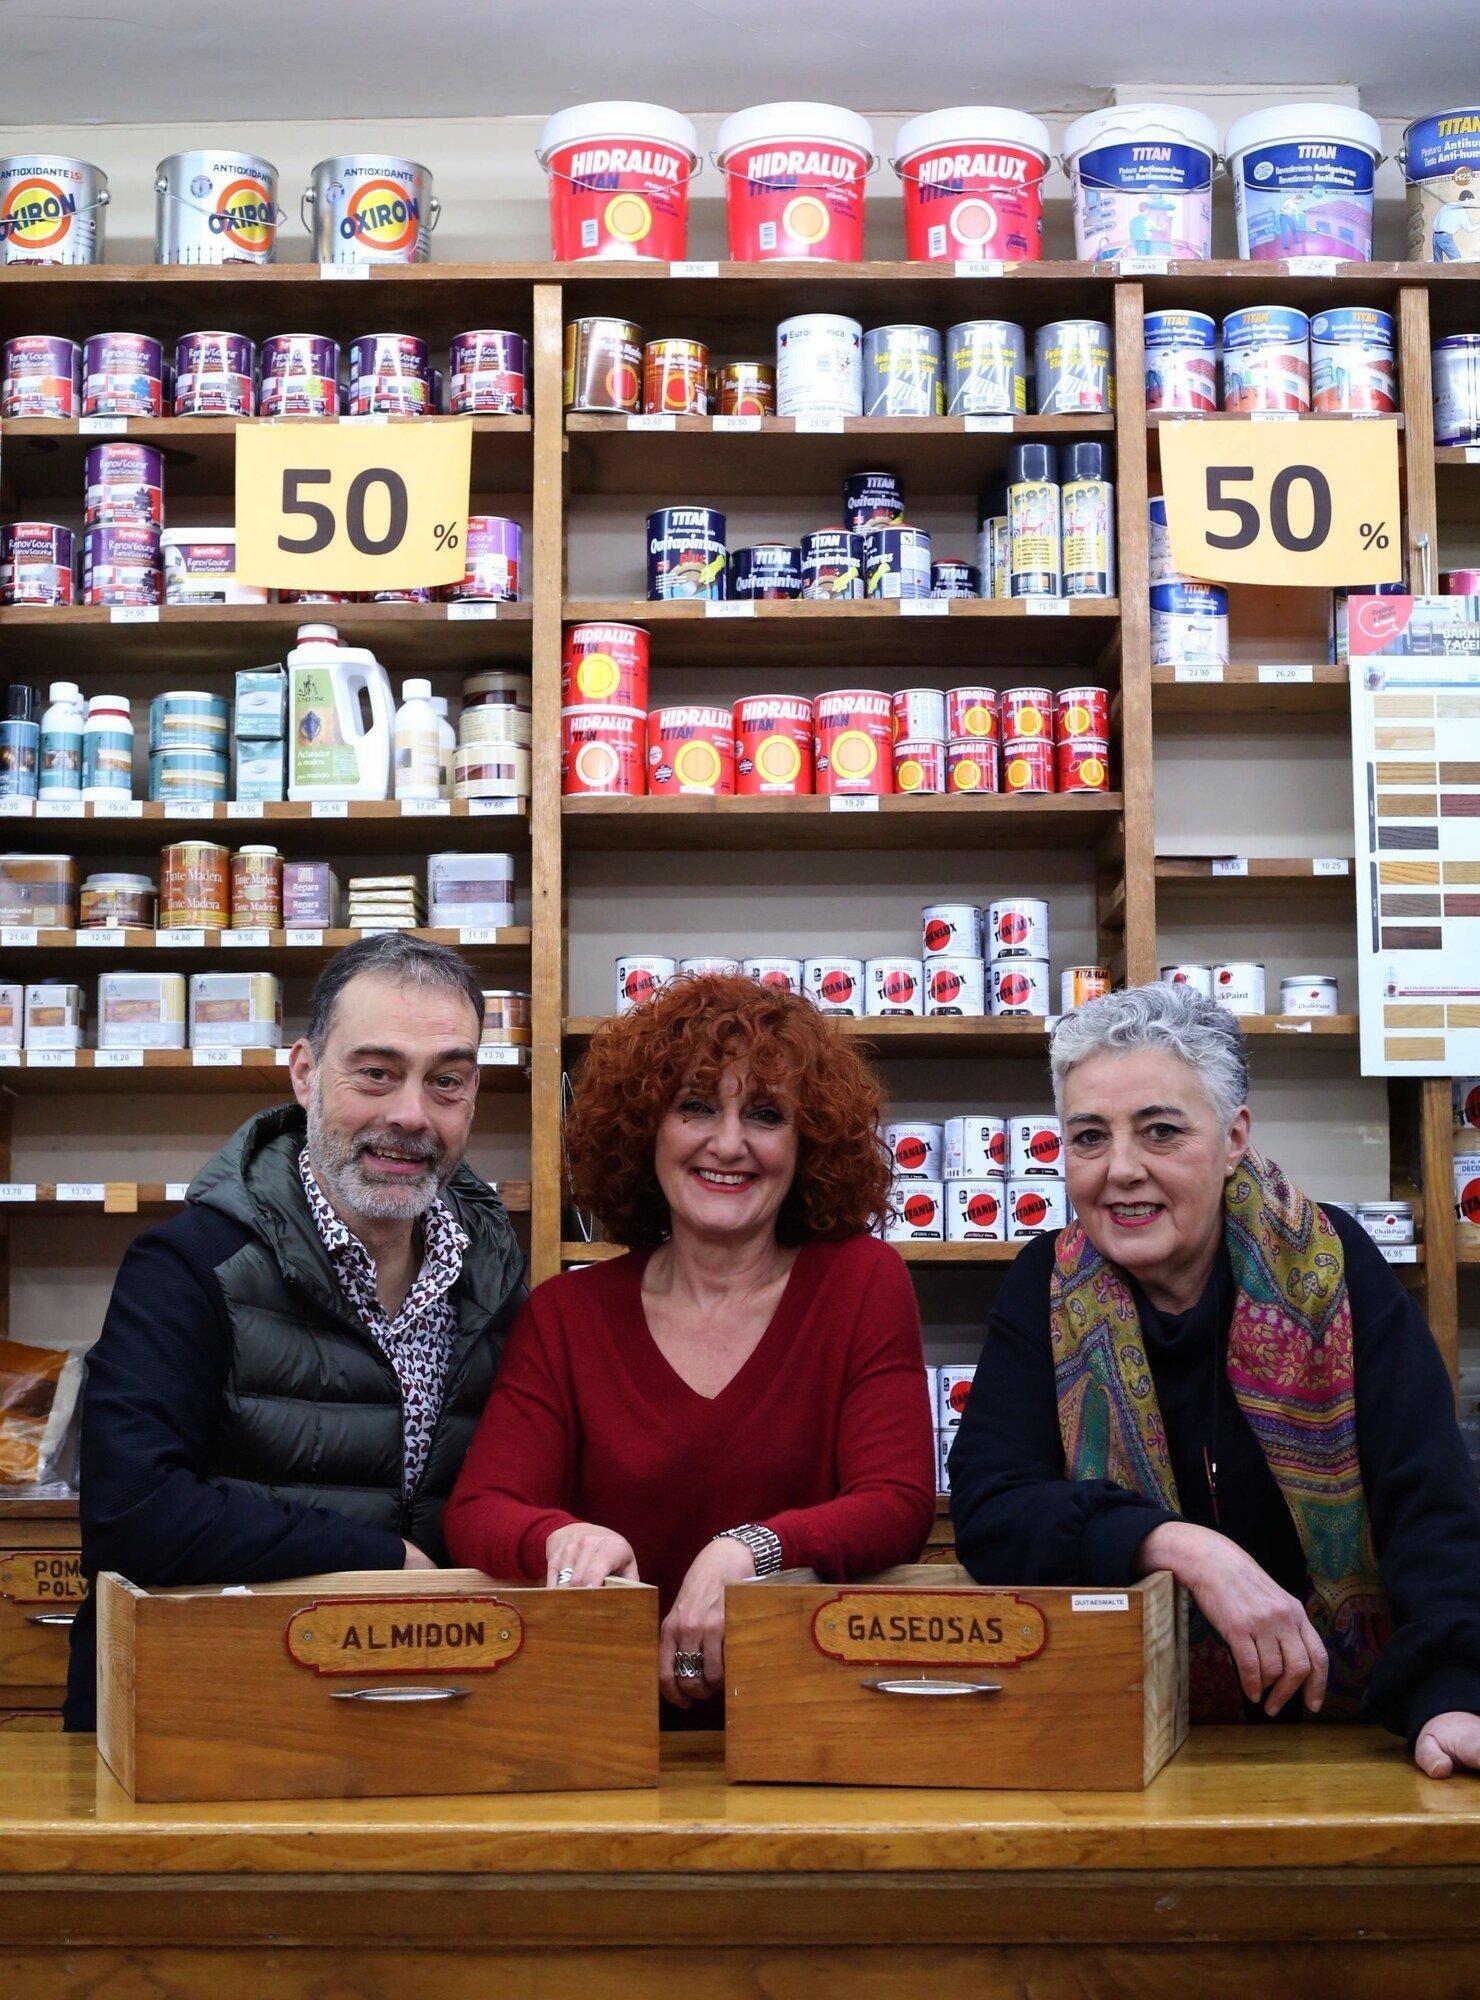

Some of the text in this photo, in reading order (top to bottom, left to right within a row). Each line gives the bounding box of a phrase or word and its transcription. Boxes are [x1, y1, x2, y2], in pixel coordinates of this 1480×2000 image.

[1298, 145, 1337, 159] TITAN
[1444, 138, 1480, 152] Antihu
[1132, 147, 1171, 161] TITAN
[1438, 149, 1480, 164] Anti-hum
[571, 148, 680, 183] HIDRALUX
[748, 150, 857, 185] HIDRALUX
[919, 153, 1027, 186] HIDRALUX
[0, 167, 70, 181] ANTIOXIDANTE
[343, 167, 414, 183] ANTIOXIDANTE
[570, 171, 620, 195] TITAN
[748, 175, 797, 198] TITAN
[919, 178, 963, 204] TITAN
[0, 193, 76, 241] OXIRON
[208, 201, 275, 235] OXIRON
[340, 198, 418, 240] OXIRON
[1163, 316, 1189, 326] TITAN
[1242, 314, 1270, 325] TITAN
[1352, 313, 1377, 323] TITAN
[867, 477, 895, 490] TITAN
[848, 495, 905, 512] Quitapintur
[1205, 465, 1389, 552] 50 %
[277, 469, 409, 556] 50
[432, 521, 458, 550] %
[671, 511, 710, 526] TITAN
[811, 535, 841, 549] TITAN
[755, 551, 793, 566] TITAN
[865, 553, 894, 568] turas
[938, 567, 970, 581] TITAN
[736, 572, 801, 592] Quitapintur
[1183, 583, 1210, 595] TITAN
[571, 628, 637, 646] HIDRALUX
[1443, 628, 1480, 639] BARNI
[572, 643, 598, 655] TITAN
[1453, 640, 1480, 650] ACEI
[1007, 690, 1047, 703] HIDRALUX
[742, 701, 812, 723] HIDRALUX
[820, 696, 891, 718] HIDRALUX
[570, 716, 634, 733] HIDRALUX
[660, 709, 733, 731] HIDRALUX
[742, 718, 774, 734] TITAN
[820, 713, 850, 731] TITAN
[571, 730, 597, 743] TITAN
[660, 726, 695, 741] TITAN
[236, 803, 256, 813] 21,50
[320, 804, 341, 814] 25,10
[845, 799, 865, 808] 19,20
[1220, 861, 1241, 870] 10,65
[1321, 861, 1342, 870] 10,25
[165, 866, 223, 884] Tinte Madera
[234, 873, 278, 887] Tinte Madera
[293, 882, 320, 895] Repara
[167, 895, 221, 911] Tinte Madeira
[234, 900, 278, 916] Tinte Madeira
[293, 899, 320, 912] Repara
[91, 932, 112, 941] 12,50
[468, 930, 490, 940] 11,10
[816, 976, 857, 1000] TITANLUX
[877, 976, 918, 1000] TITANLUX
[927, 974, 966, 1001] TITANLUX
[996, 977, 1037, 1003] TITANLUX
[208, 1051, 229, 1061] 16,20
[484, 1051, 505, 1060] 13,70
[1461, 1164, 1480, 1174] DECO
[2, 1187, 22, 1197] 13,70
[71, 1187, 92, 1197] 13,70
[900, 1198, 939, 1224] TITANLUX
[962, 1198, 1002, 1224] TITANLUX
[1012, 1196, 1053, 1224] TITANLUX
[1374, 1227, 1407, 1235] ChalkPaint
[34, 1559, 81, 1579] POM
[38, 1580, 90, 1597] POLV
[1072, 1597, 1126, 1606] QUITAESMALTE
[340, 1621, 485, 1650] ALMIDON
[847, 1614, 1004, 1645] GASEOSAS
